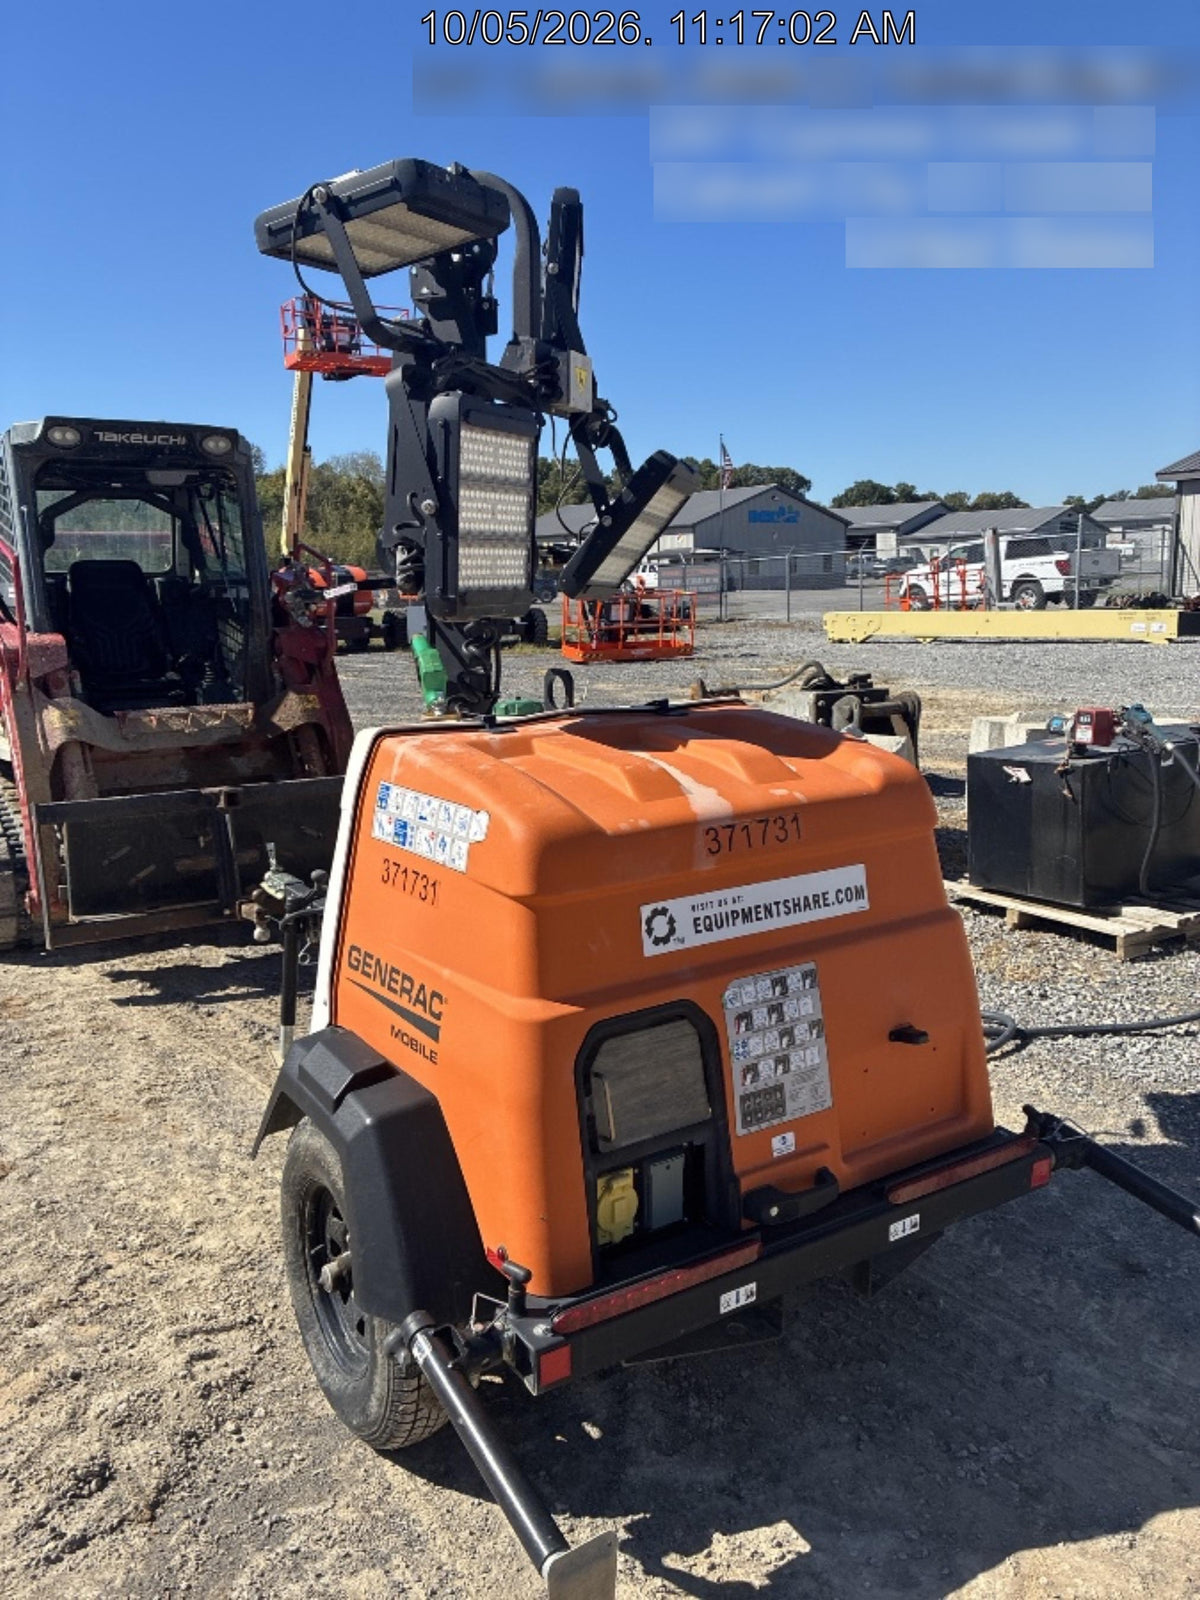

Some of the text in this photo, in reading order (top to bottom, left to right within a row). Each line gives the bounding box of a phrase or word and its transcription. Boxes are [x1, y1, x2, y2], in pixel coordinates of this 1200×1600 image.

[704, 812, 801, 855] 371731
[381, 858, 439, 906] 371731
[691, 900, 714, 912] VISIT
[693, 884, 866, 934] EQUIPMENTSHARE.COM
[347, 943, 444, 1021] GENERAC
[390, 1023, 439, 1066] MOBILE
